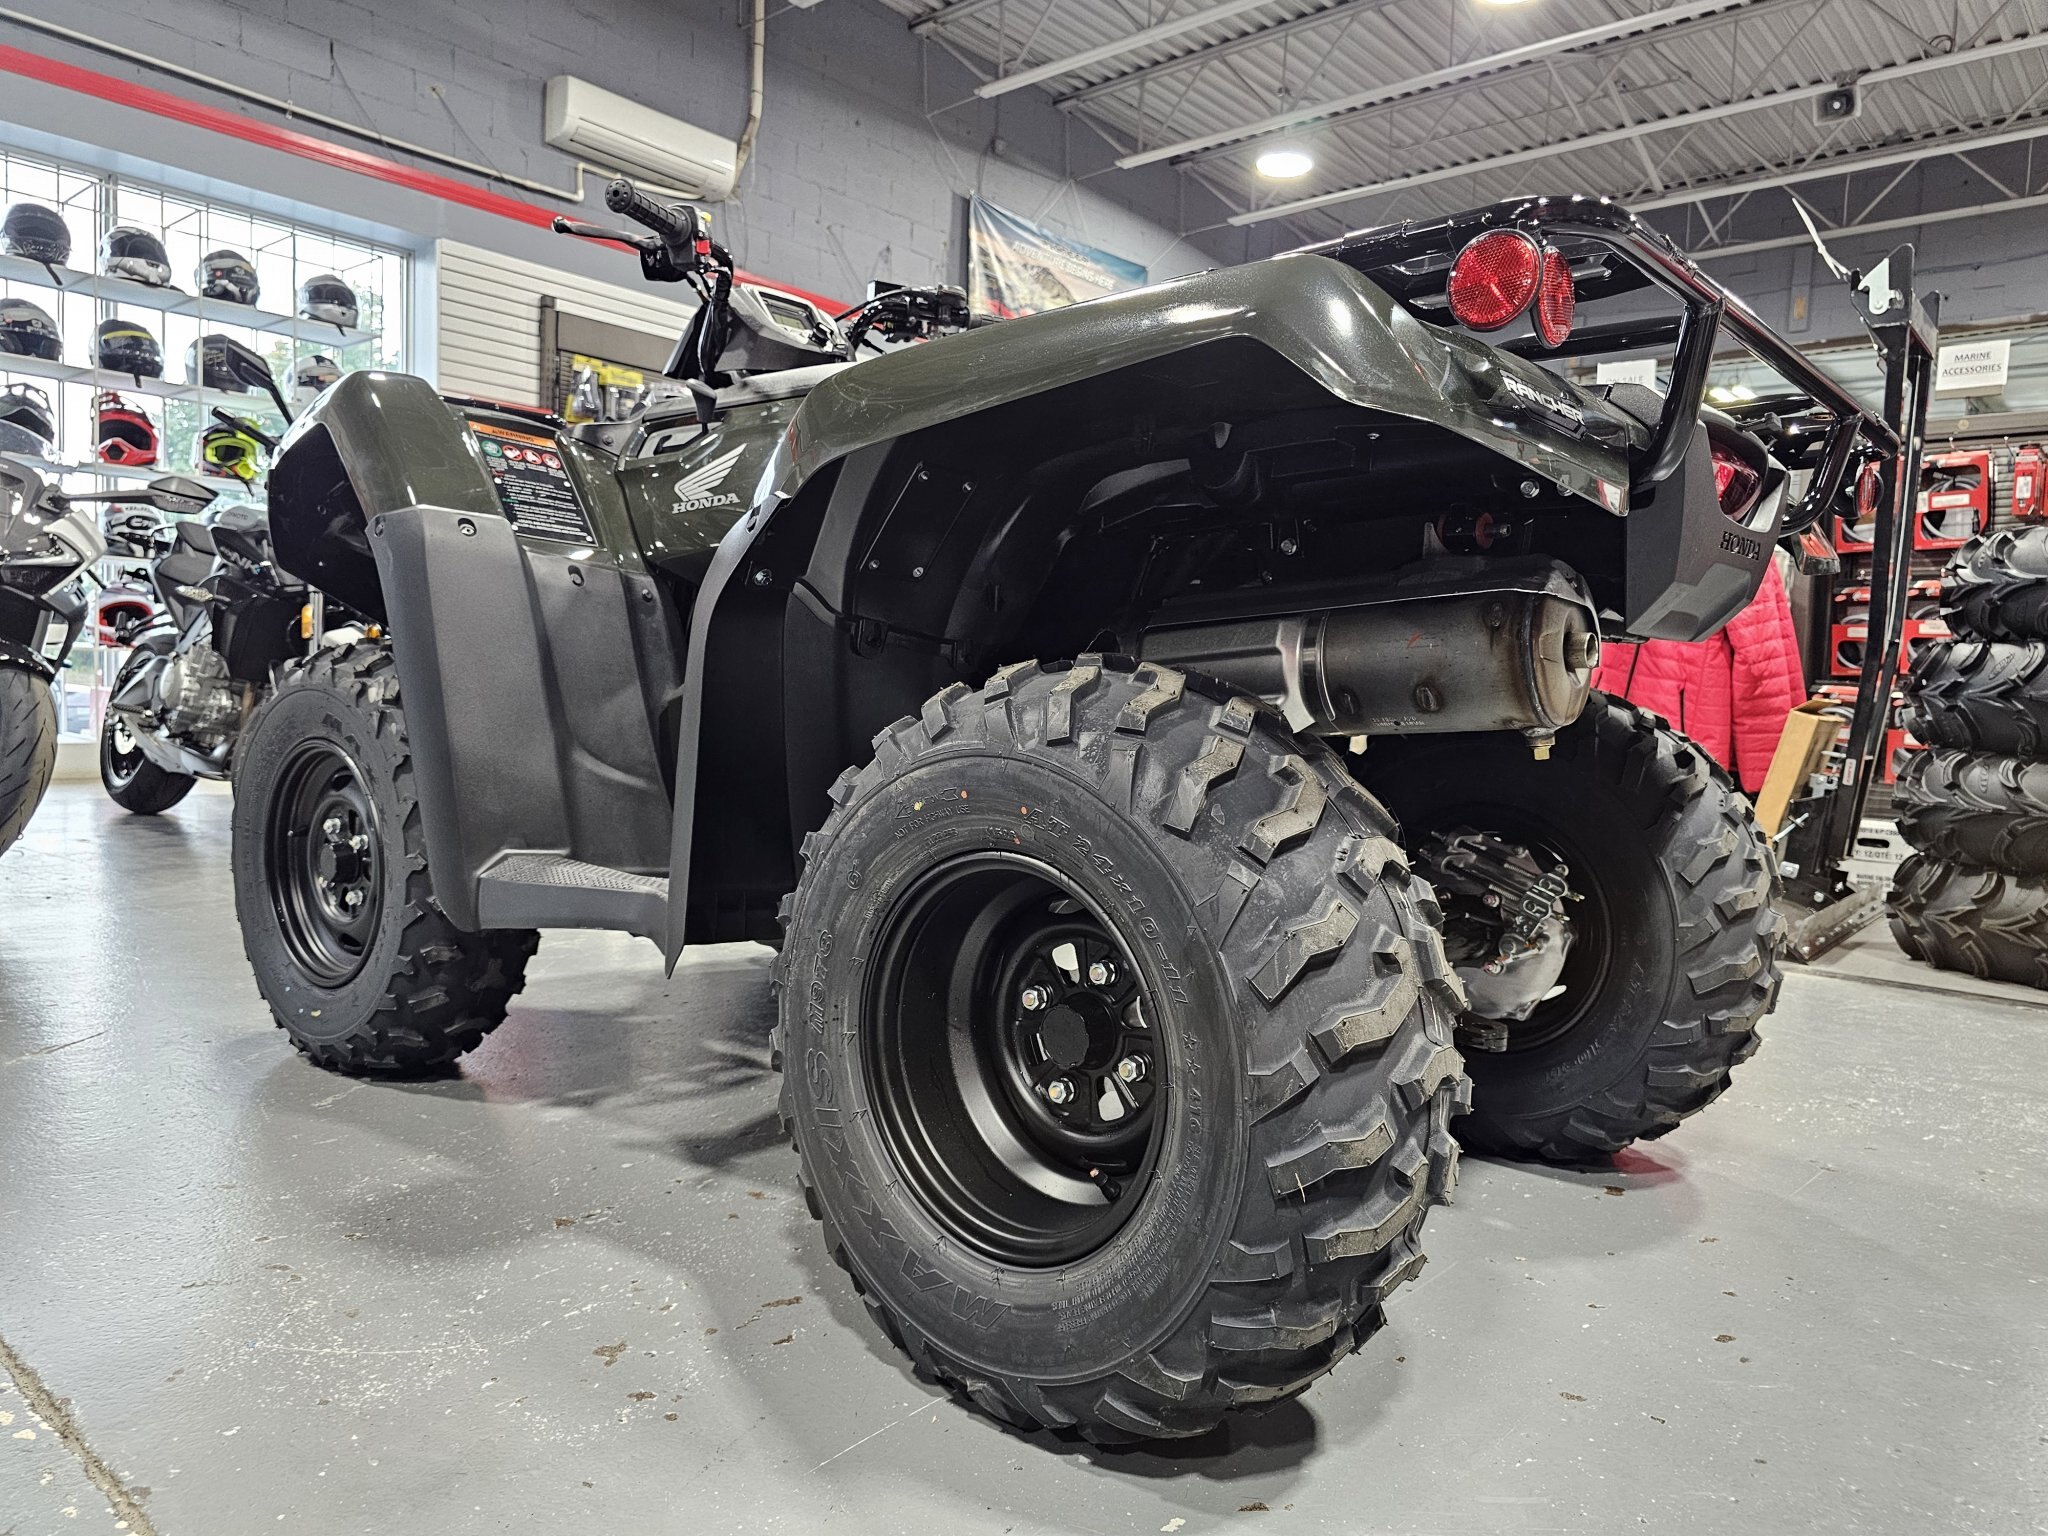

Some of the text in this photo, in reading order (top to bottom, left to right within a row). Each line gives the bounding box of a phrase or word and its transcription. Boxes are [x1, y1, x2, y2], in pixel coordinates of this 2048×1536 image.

[1954, 351, 1992, 362] MARINE
[1942, 363, 2002, 377] ACCESSORIES
[1503, 377, 1585, 425] RANCHER
[672, 493, 740, 514] HONDA
[1720, 531, 1760, 560] HONDA
[956, 802, 971, 815] USE
[1023, 806, 1070, 839] AT
[806, 1047, 1011, 1330] MAXXIS
